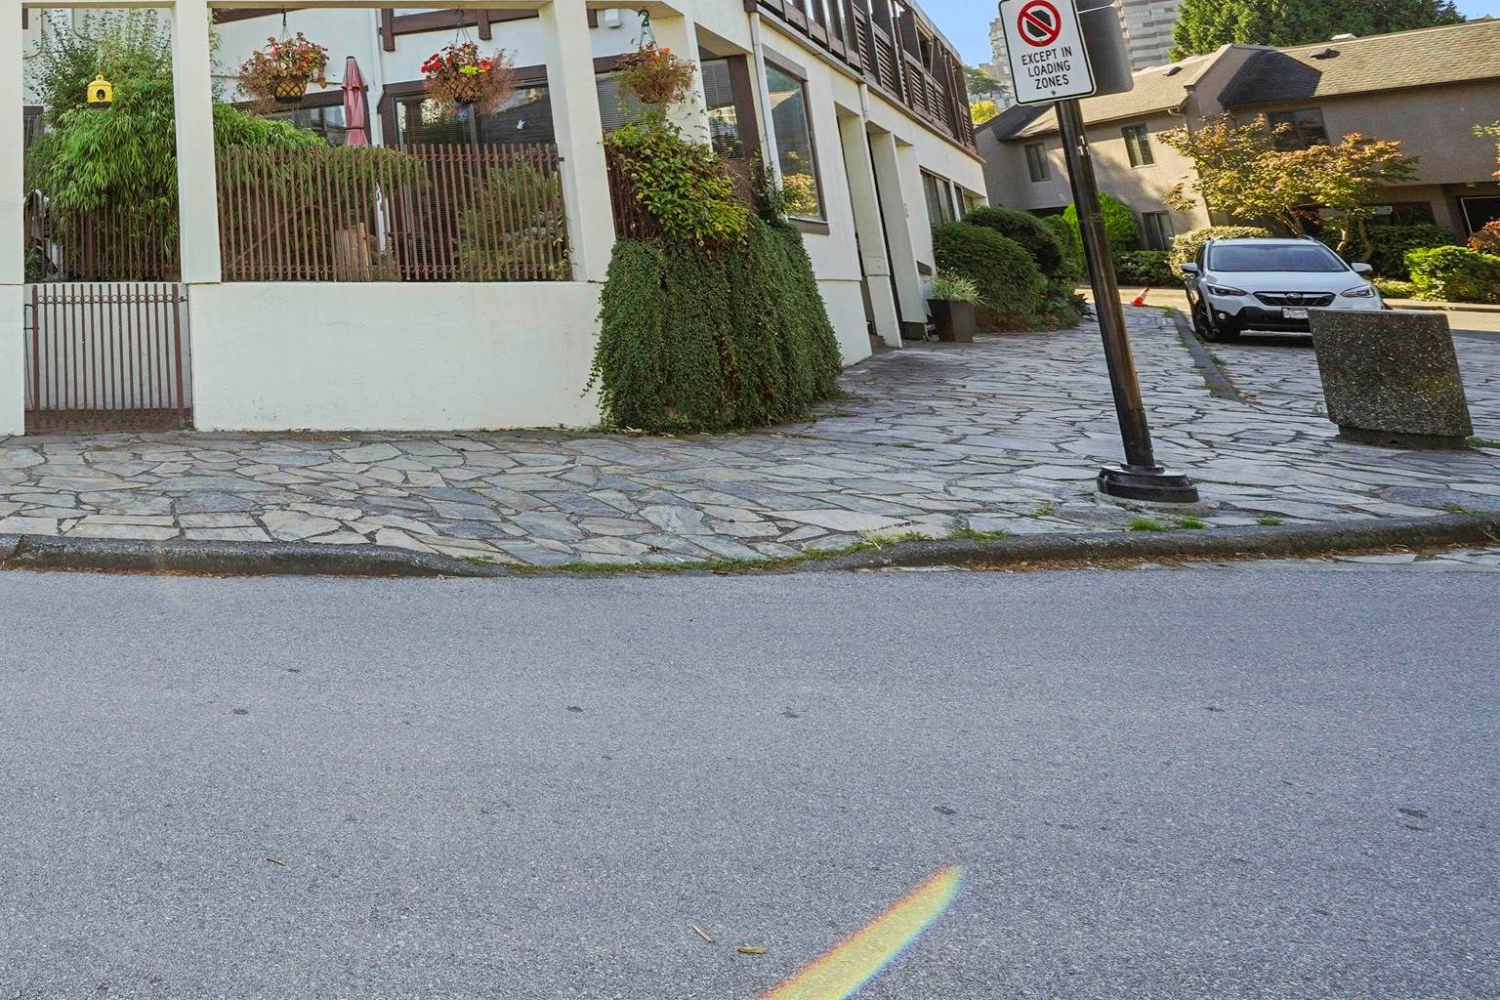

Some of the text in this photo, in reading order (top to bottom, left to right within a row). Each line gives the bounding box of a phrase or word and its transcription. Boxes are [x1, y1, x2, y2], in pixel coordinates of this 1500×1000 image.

[1021, 46, 1073, 66] EXCEPT IN
[1028, 60, 1071, 78] LOADING
[1034, 74, 1070, 90] ZONES
